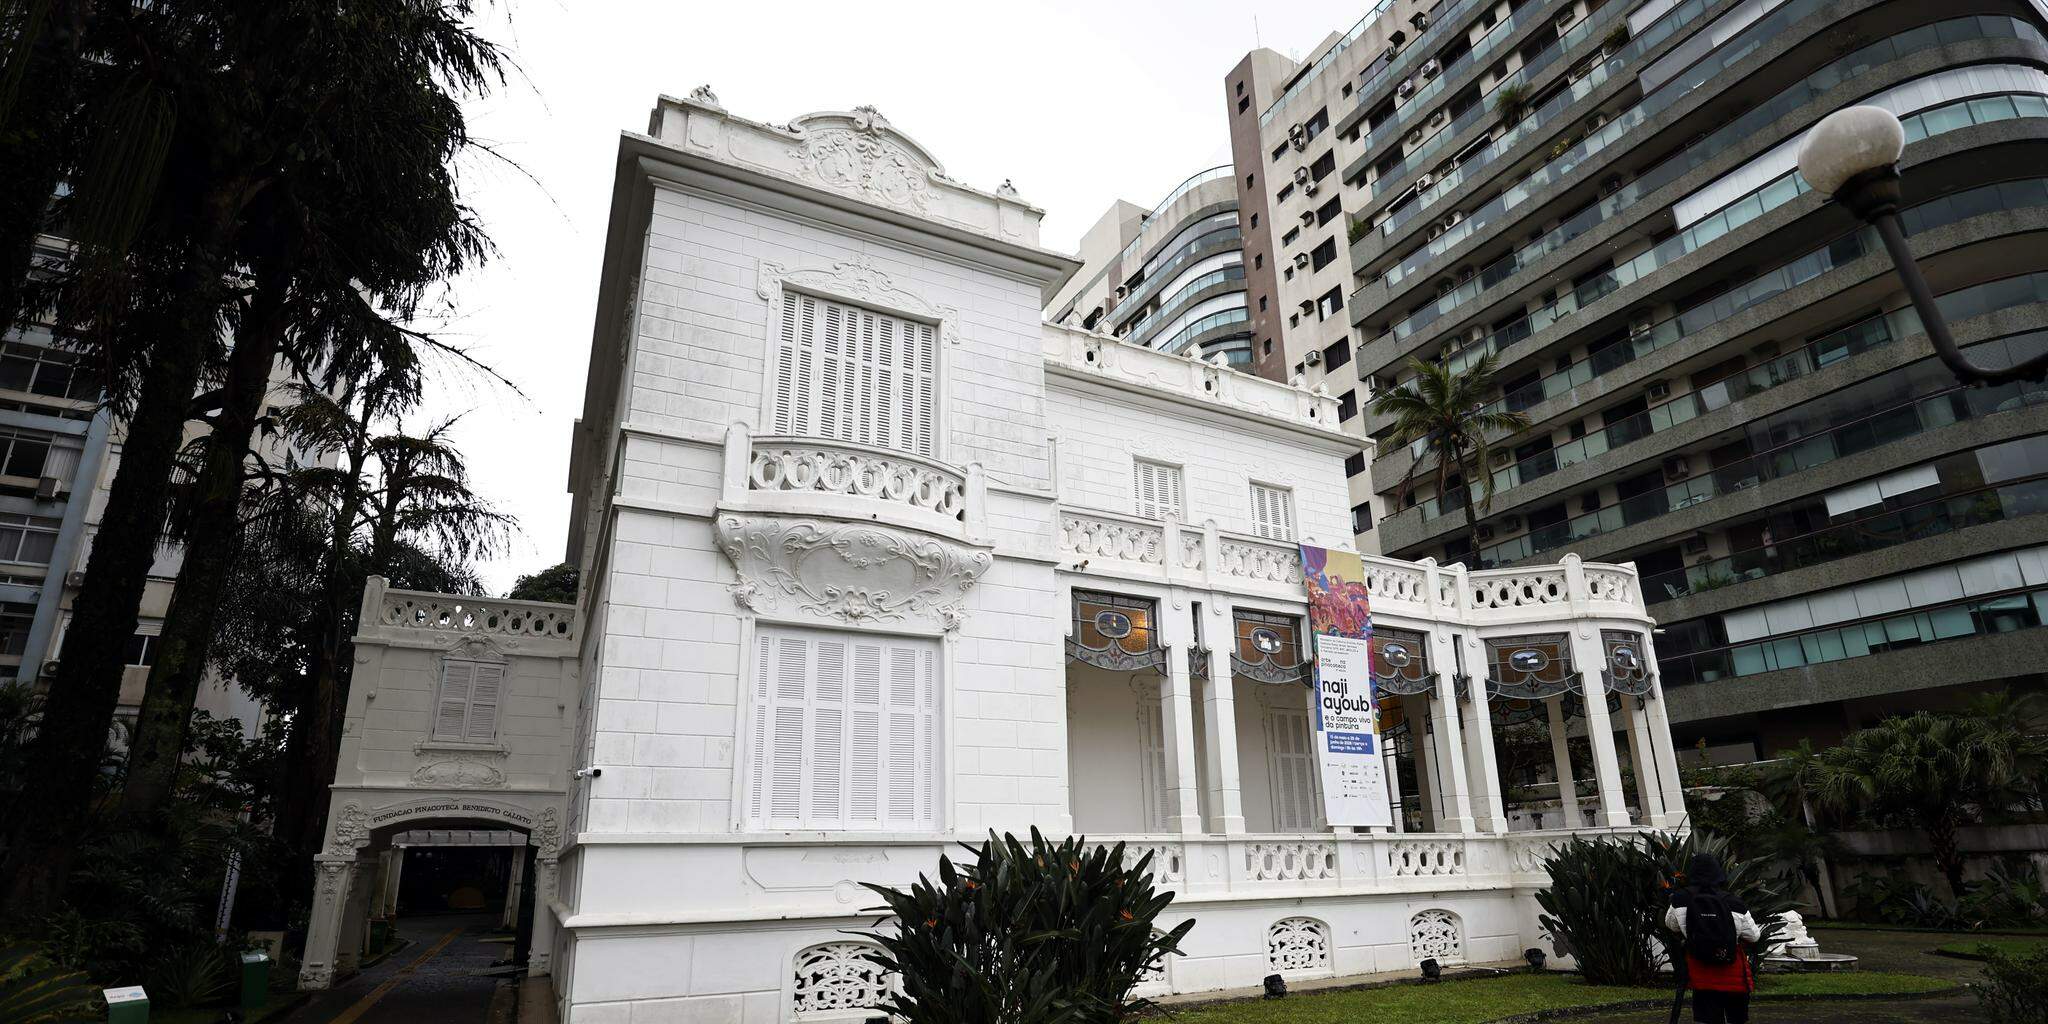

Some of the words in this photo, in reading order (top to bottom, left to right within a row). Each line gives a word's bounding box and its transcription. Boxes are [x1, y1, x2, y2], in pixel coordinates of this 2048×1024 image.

[1322, 678, 1348, 698] naji
[1323, 695, 1370, 715] ayoub
[1335, 722, 1359, 730] pintura
[1336, 716, 1358, 724] campo
[414, 804, 459, 813] PINACOTECA
[462, 804, 501, 814] BENEDICTO
[502, 810, 532, 824] CALIXTO
